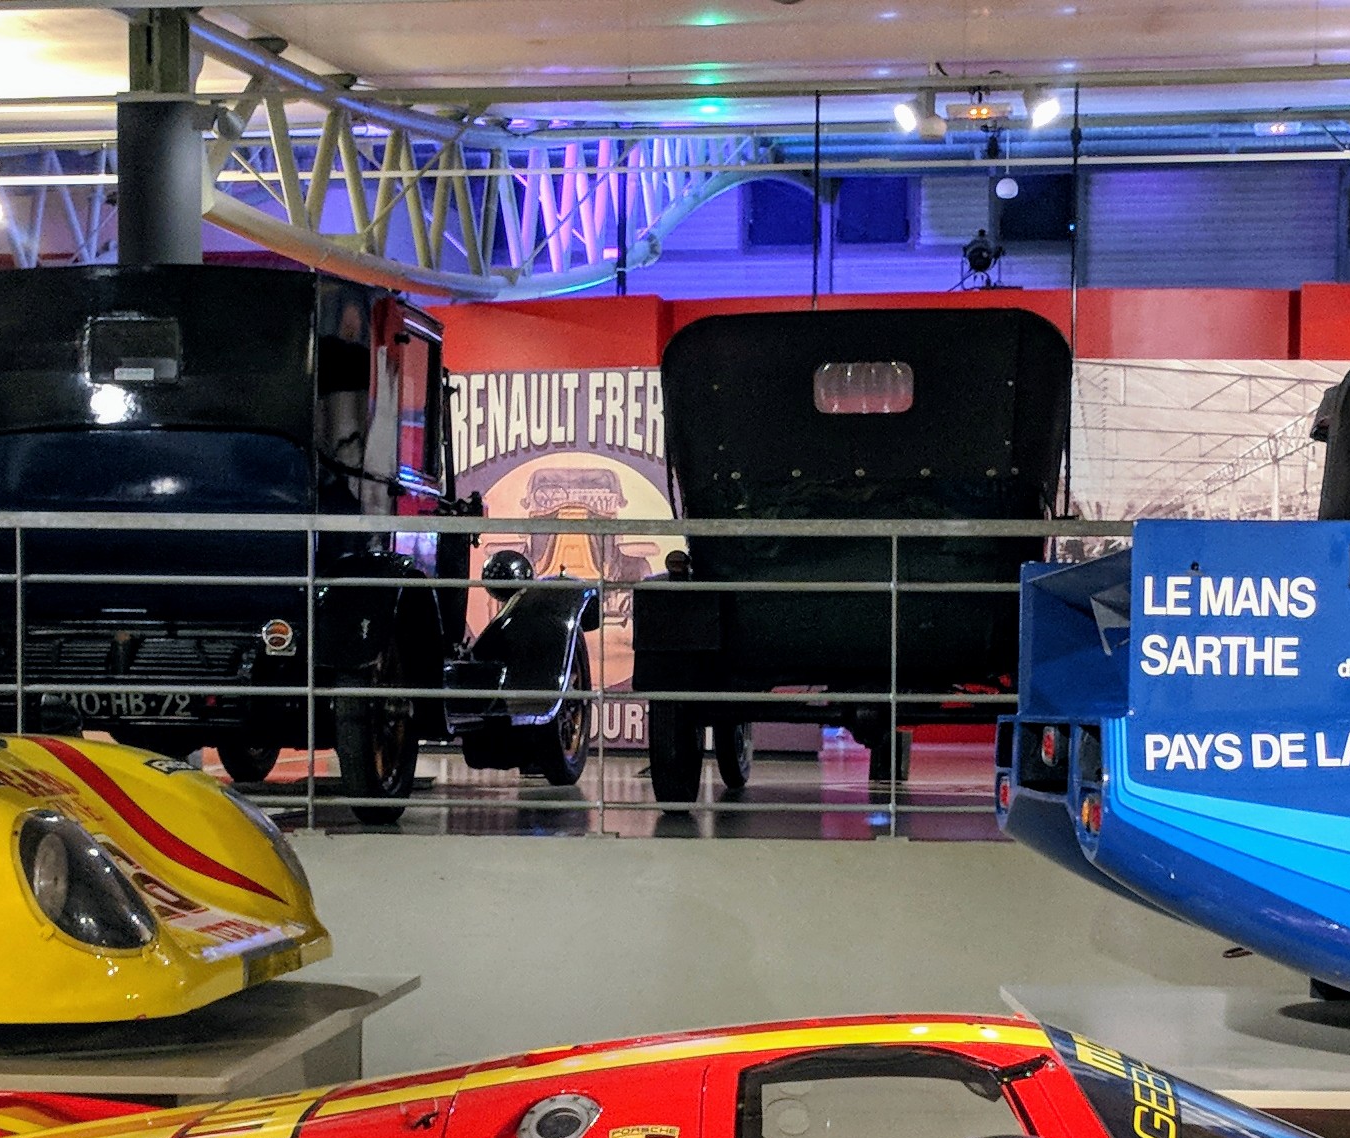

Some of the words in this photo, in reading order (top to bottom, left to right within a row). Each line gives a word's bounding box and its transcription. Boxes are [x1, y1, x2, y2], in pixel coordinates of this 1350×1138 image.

[449, 372, 579, 474] RENAULT
[1143, 576, 1190, 616] LE
[1199, 576, 1316, 619] MANS
[1140, 635, 1299, 676] SARTHE
[1144, 733, 1242, 770] PAYS
[1251, 732, 1308, 768] DE
